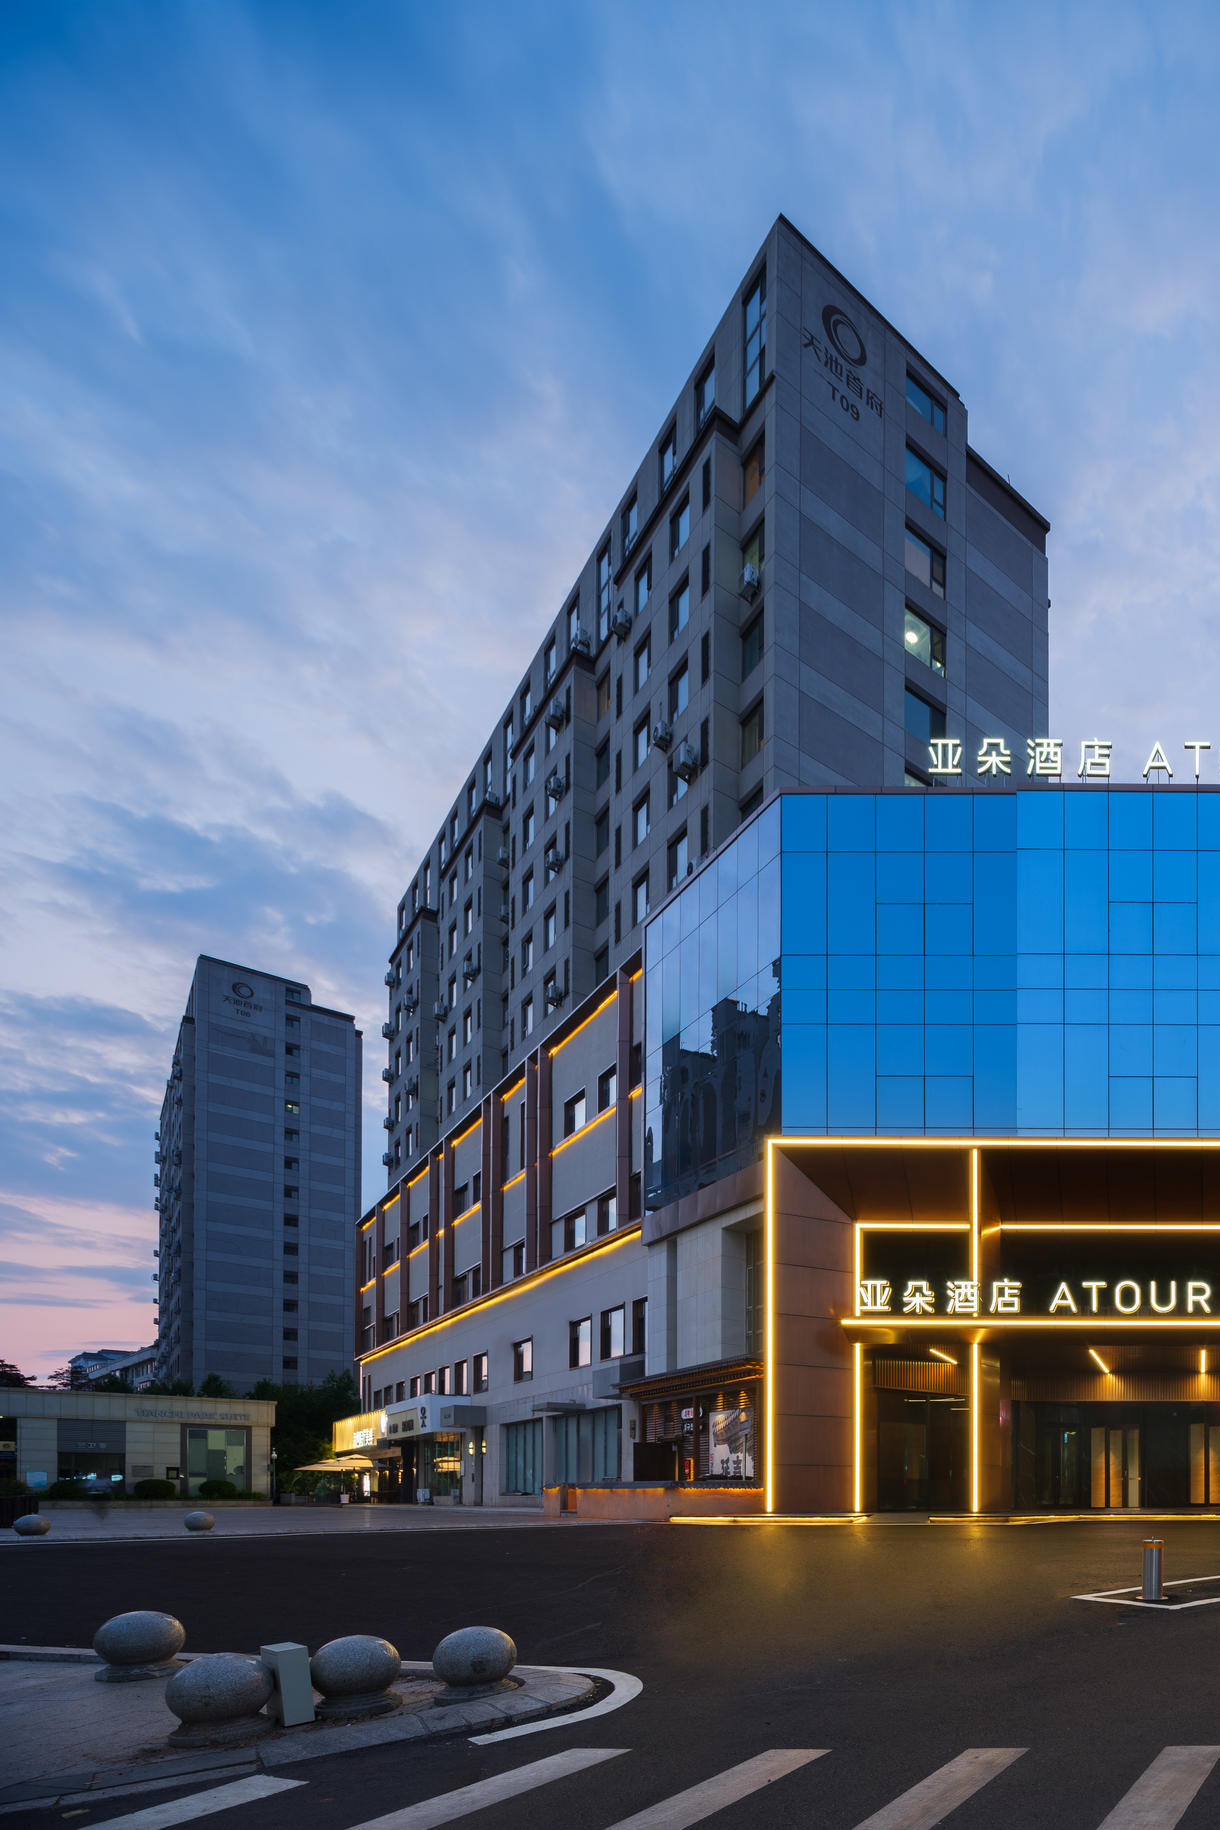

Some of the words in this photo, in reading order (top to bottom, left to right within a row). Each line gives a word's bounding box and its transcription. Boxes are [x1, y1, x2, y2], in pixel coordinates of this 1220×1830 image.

[802, 327, 883, 418] 天池首府
[826, 381, 860, 421] T09
[927, 736, 1113, 780] 亚朵酒店
[859, 1279, 1022, 1314] 亚朵酒店
[1049, 1280, 1212, 1314] ATOUR
